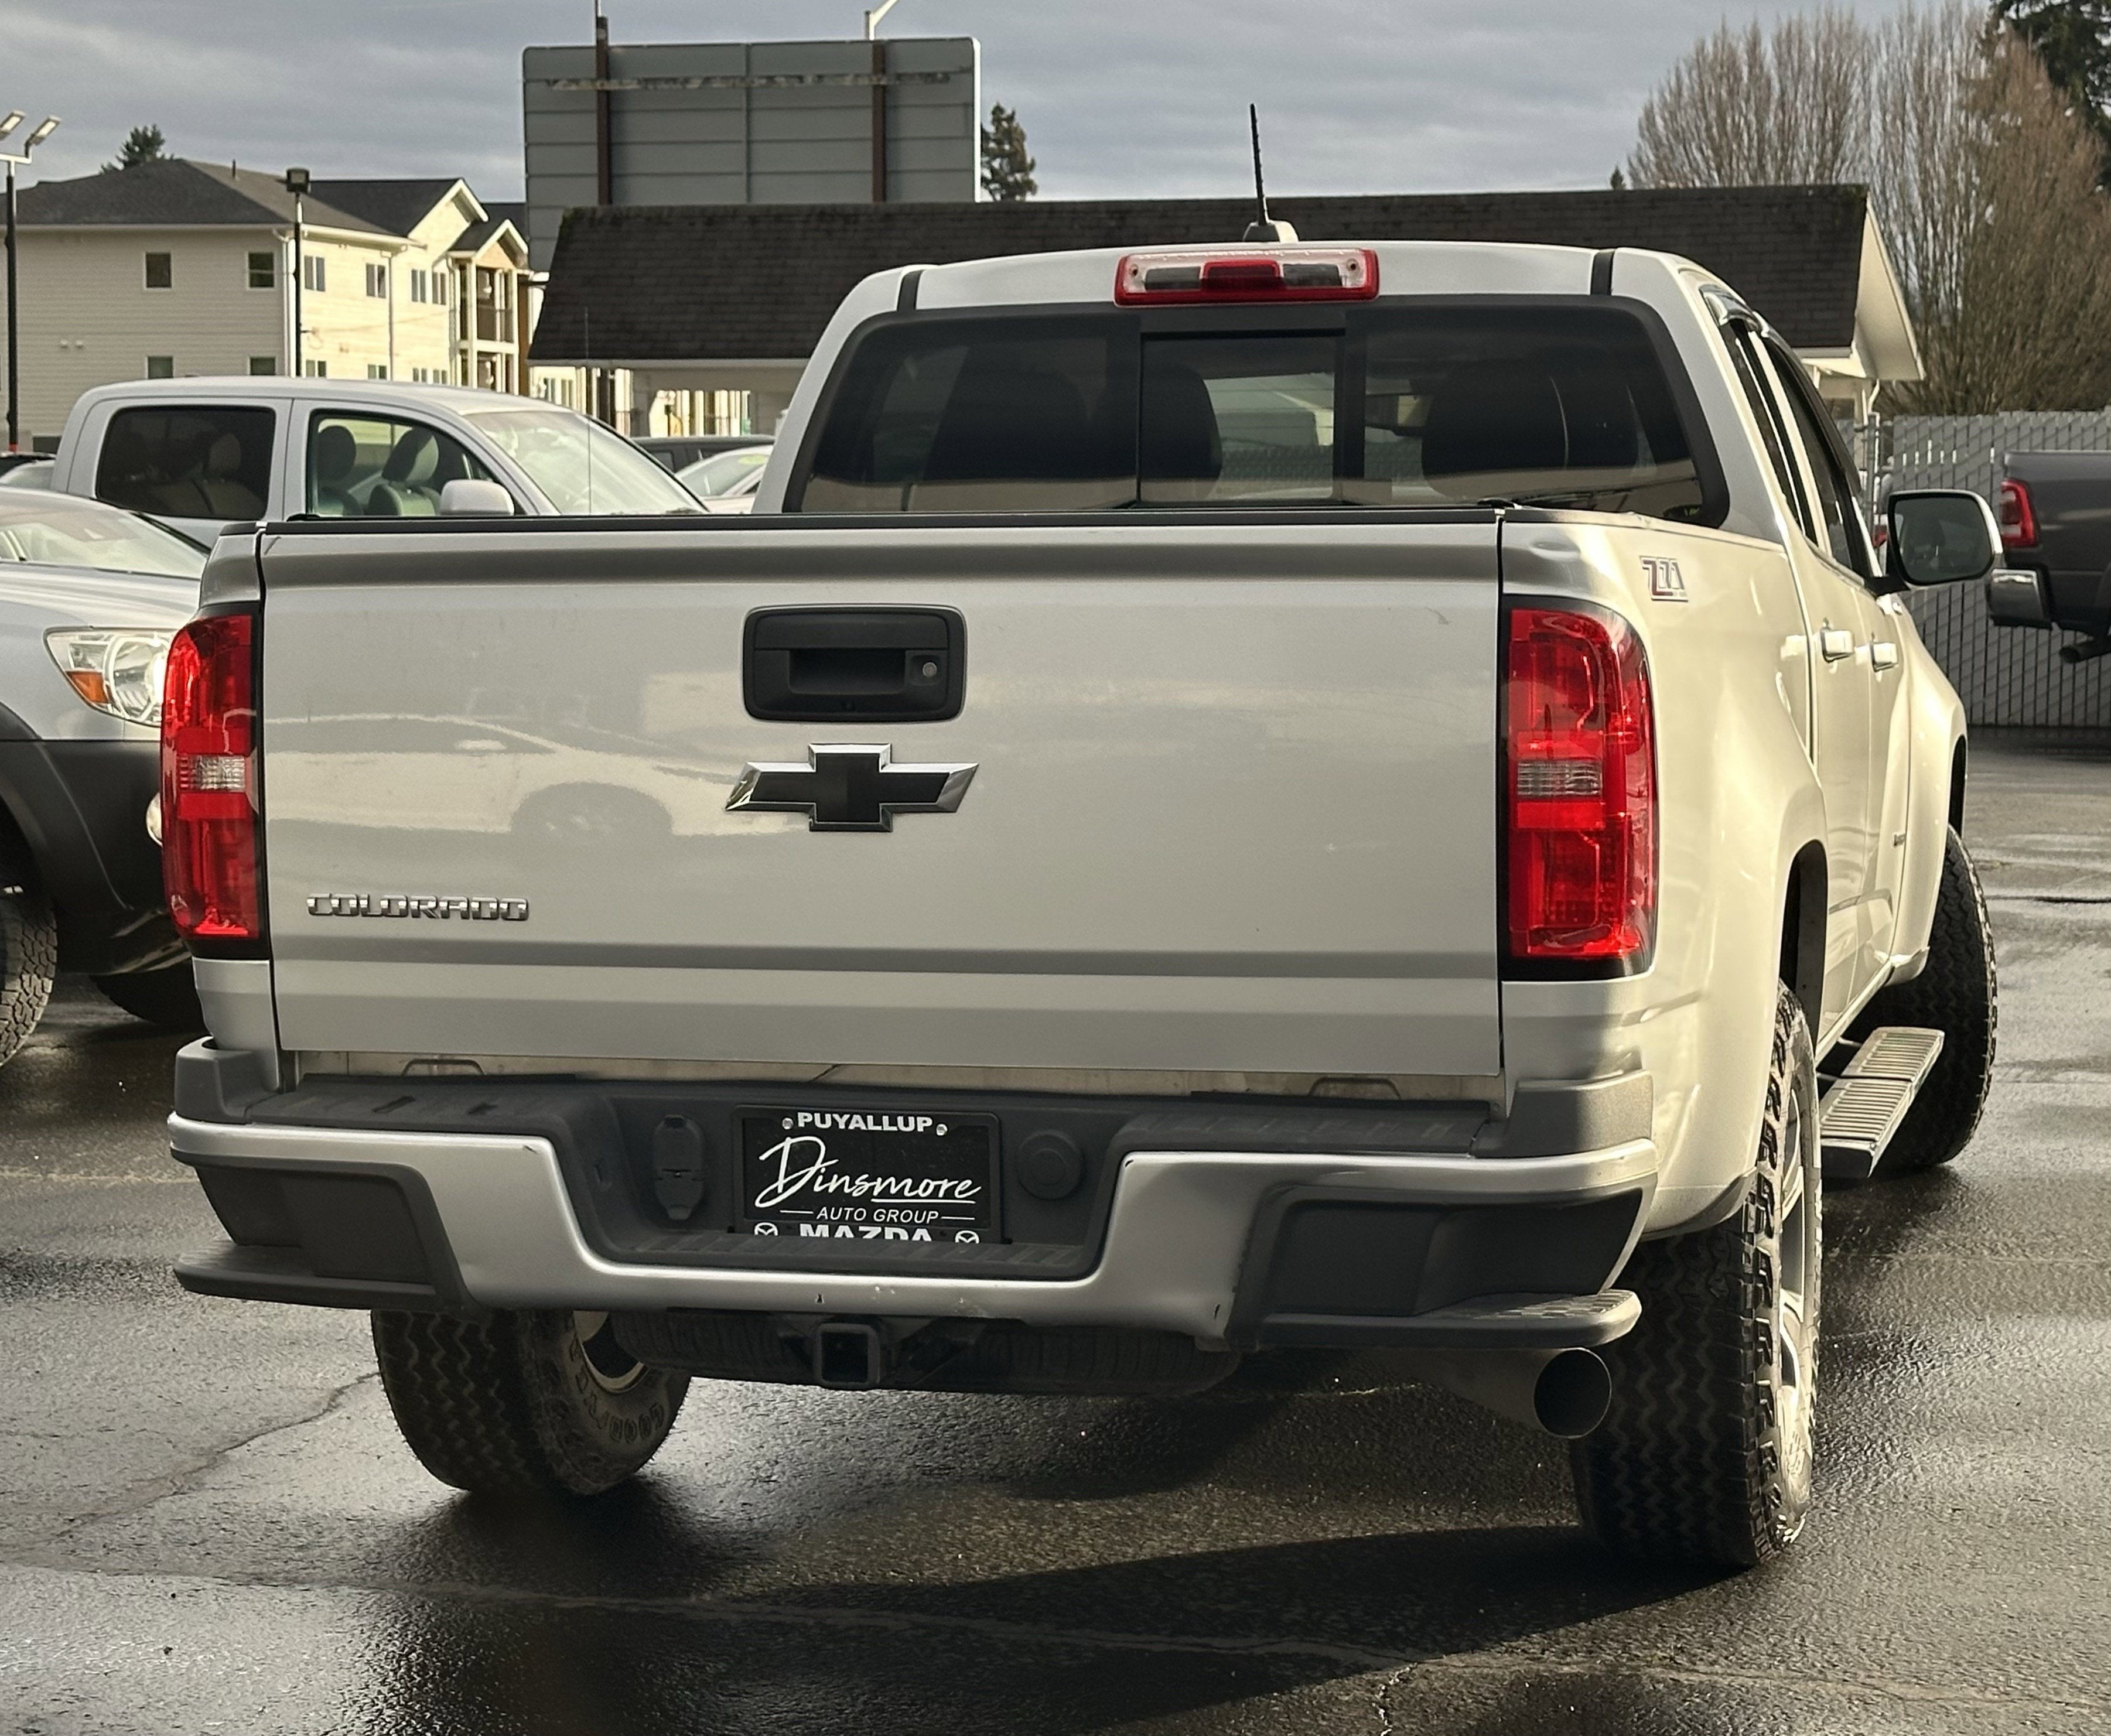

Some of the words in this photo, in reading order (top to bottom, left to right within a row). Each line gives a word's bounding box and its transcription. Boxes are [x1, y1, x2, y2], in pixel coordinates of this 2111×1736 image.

[306, 893, 529, 921] COLORADO
[797, 1112, 933, 1132] PUYALLUP
[754, 1136, 982, 1208] Dinsmore
[817, 1207, 867, 1221] AUTO
[873, 1209, 939, 1224] GROUP
